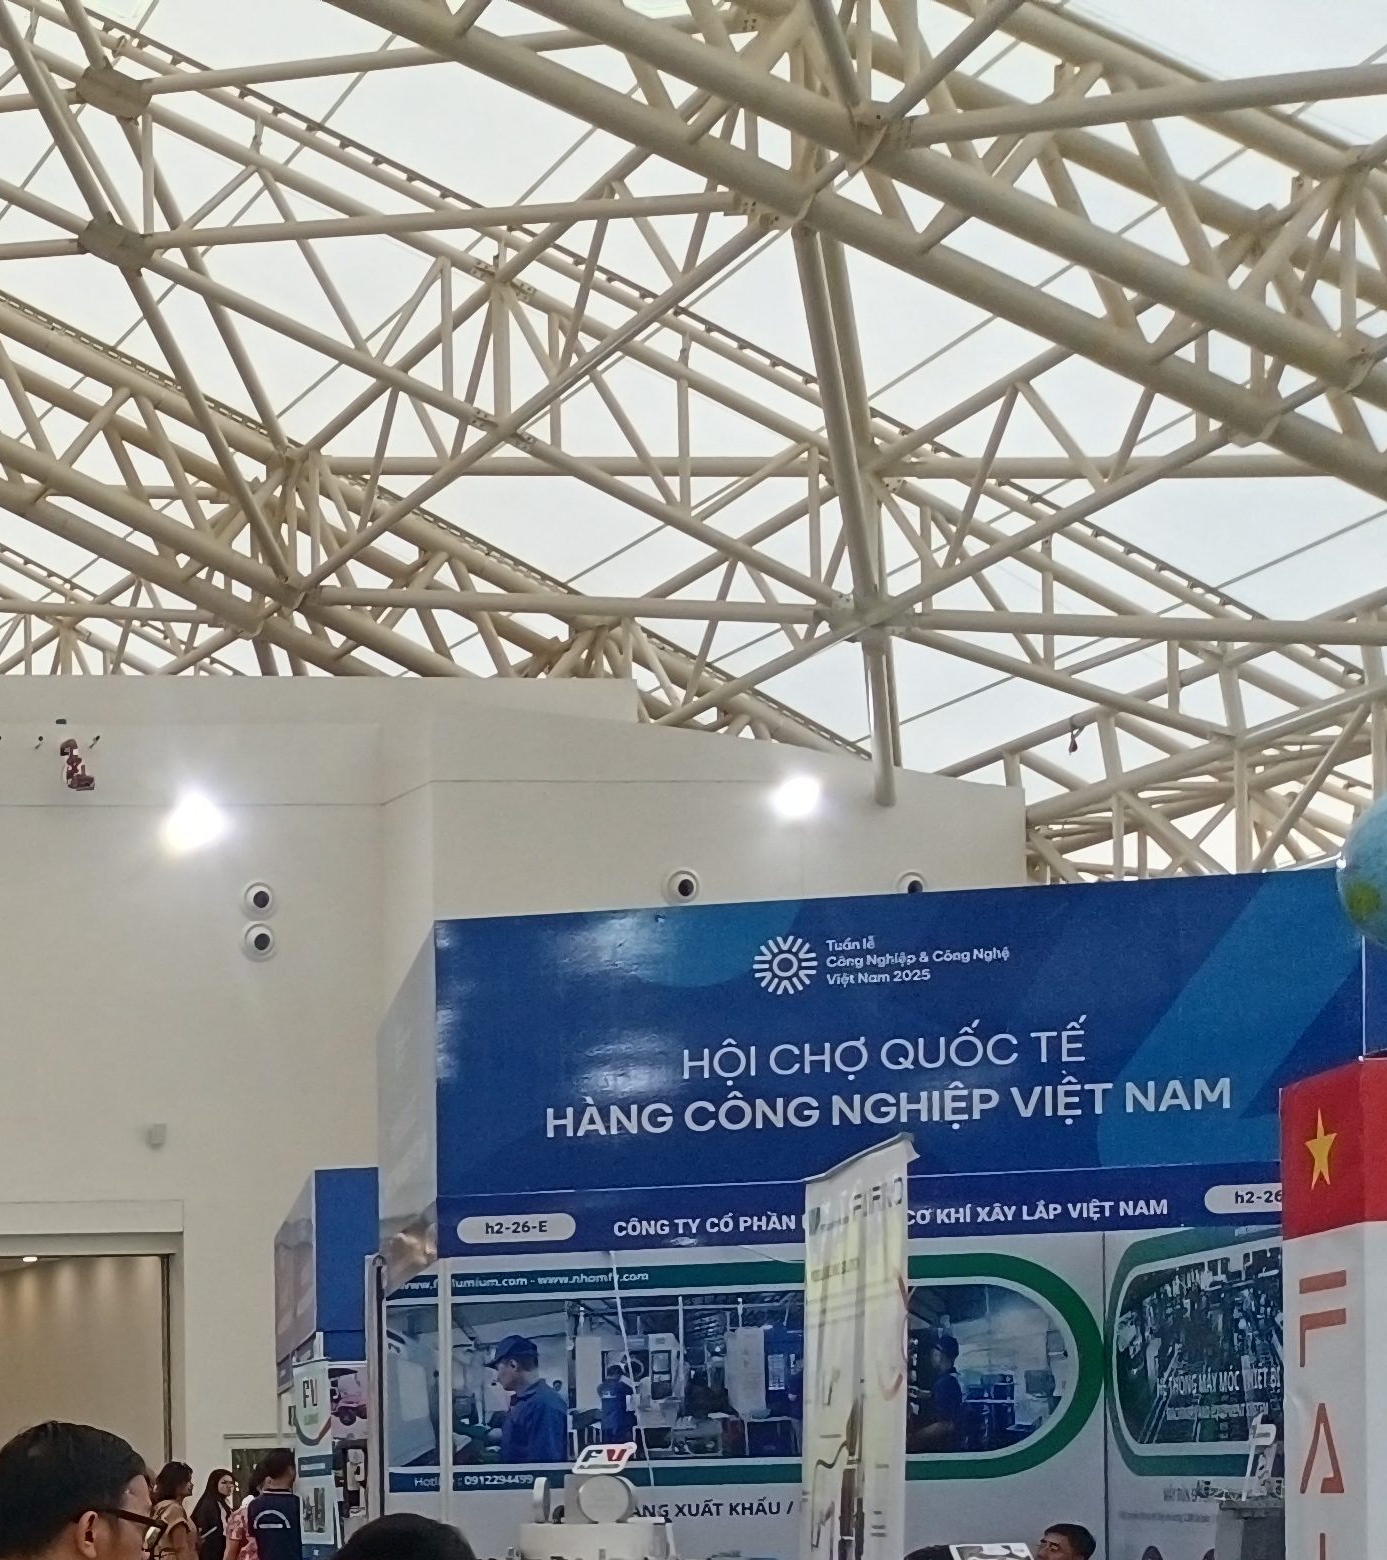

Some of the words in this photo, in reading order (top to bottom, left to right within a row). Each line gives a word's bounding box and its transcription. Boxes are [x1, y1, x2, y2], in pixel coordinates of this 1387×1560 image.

[826, 955, 864, 969] Công
[866, 952, 918, 967] Nghiệp
[919, 951, 929, 963] &
[932, 949, 971, 963] Công
[972, 946, 1011, 963] Nghệ
[826, 973, 856, 988] Việt
[857, 971, 891, 984] Nam
[893, 968, 932, 982] 2025
[682, 1037, 758, 1086] HỘI
[769, 1036, 869, 1081] CHỢ
[879, 1019, 1019, 1070] QUỐC
[1029, 1014, 1088, 1063] TẾ
[545, 1096, 674, 1139] HÀNG
[684, 1090, 820, 1133] CÔNG
[830, 1081, 1000, 1130] NGHIỆP
[1010, 1072, 1114, 1126] VIỆT
[1124, 1076, 1232, 1114] NAM
[1234, 1189, 1283, 1207] h2-26
[612, 1214, 669, 1237] CÔNG
[673, 1217, 702, 1236] TY
[704, 1208, 735, 1234] CỔ
[738, 1210, 797, 1233] PHẦN
[935, 1203, 972, 1225] KHÍ
[976, 1201, 1018, 1223] XÂY
[1022, 1198, 1063, 1222] LẮP
[1067, 1198, 1115, 1224] VIỆT
[1118, 1198, 1169, 1217] NAM
[483, 1217, 548, 1236] h2-26-E
[674, 1499, 724, 1517] XUẤT
